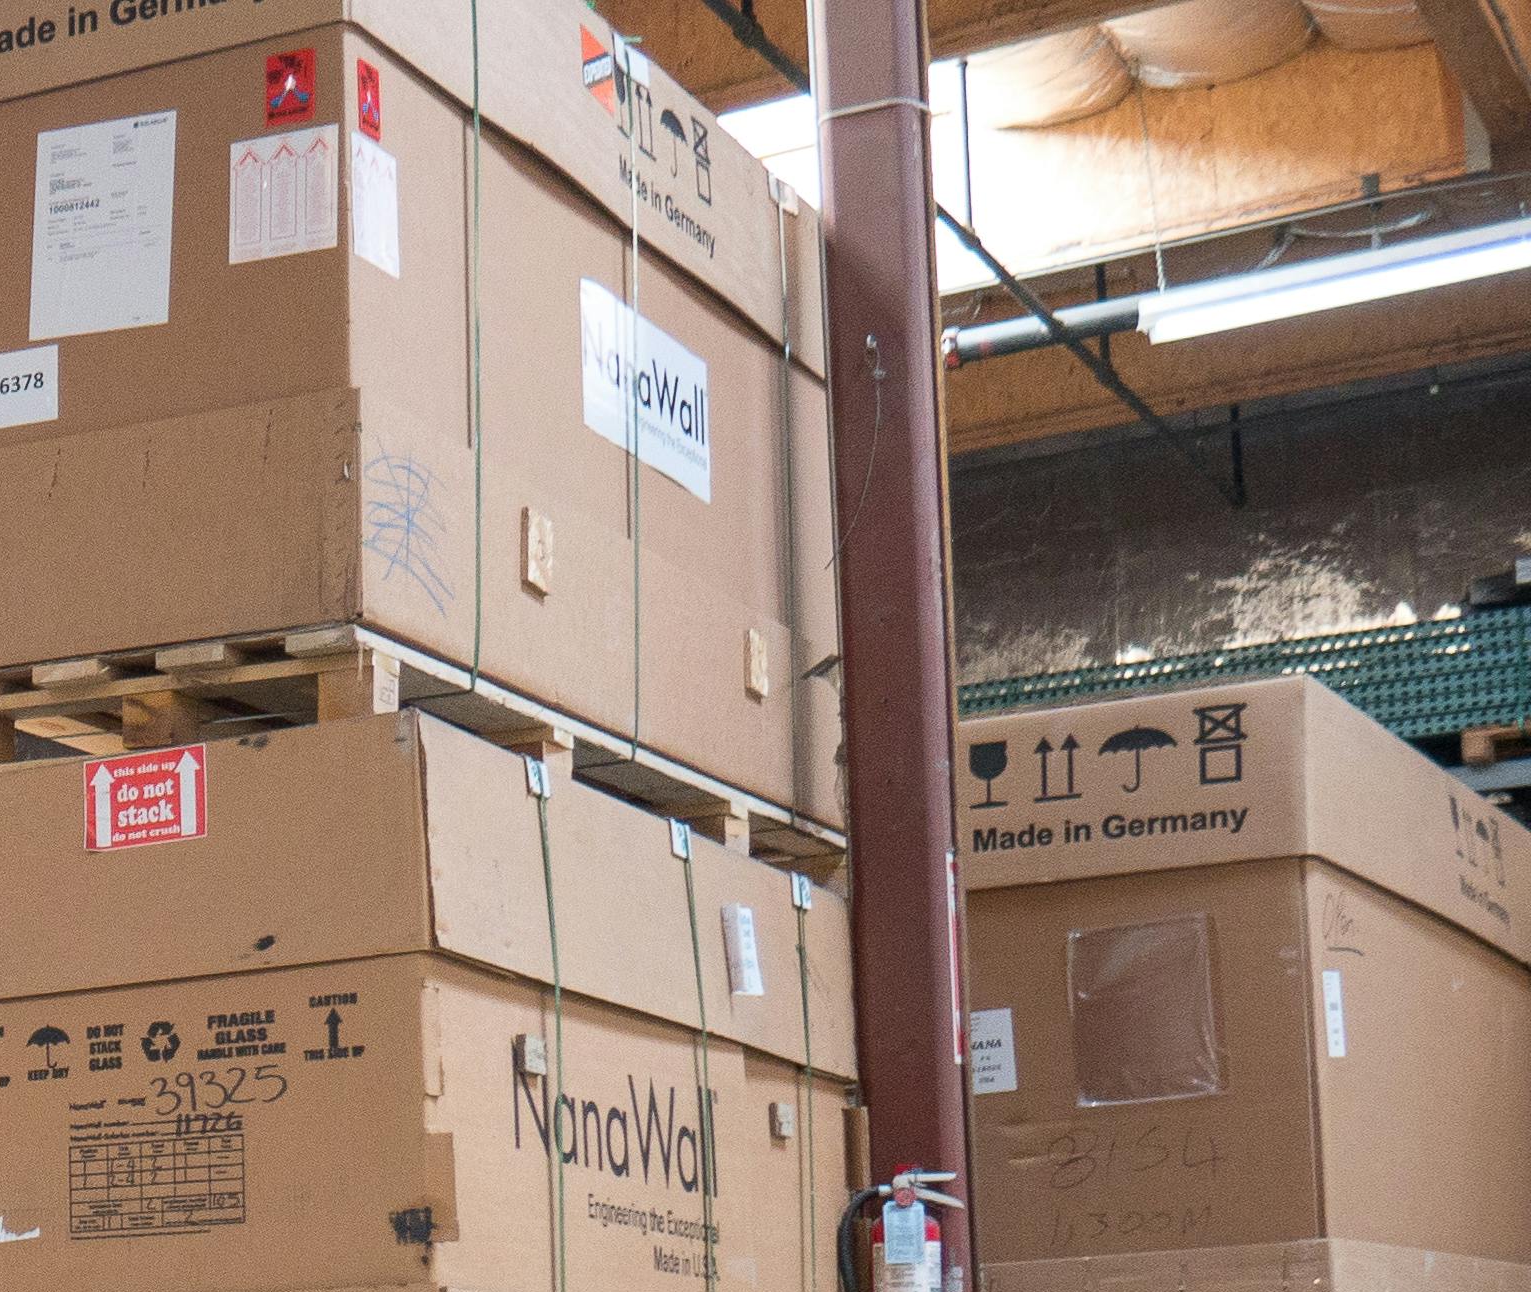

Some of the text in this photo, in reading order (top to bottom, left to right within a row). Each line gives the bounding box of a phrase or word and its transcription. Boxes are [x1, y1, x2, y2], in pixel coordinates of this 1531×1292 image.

[67, 7, 98, 37] in
[109, 0, 267, 27] Germ
[665, 195, 715, 259] Germany
[113, 761, 175, 778] this side up
[117, 778, 175, 803] do not
[118, 800, 175, 828] stack
[113, 825, 180, 842] do not crush
[973, 807, 1248, 853] Made in Germany
[308, 992, 358, 1008] CAUTION
[207, 1010, 275, 1029] FRAGILE
[90, 1040, 122, 1056] STACK
[215, 1028, 268, 1046] GLASS
[89, 1056, 123, 1072] GLASS
[149, 1064, 288, 1116] 39325
[511, 1036, 718, 1198] NanaWall
[588, 1193, 647, 1236] Engineering
[649, 1206, 665, 1233] the
[654, 1245, 681, 1275] Made
